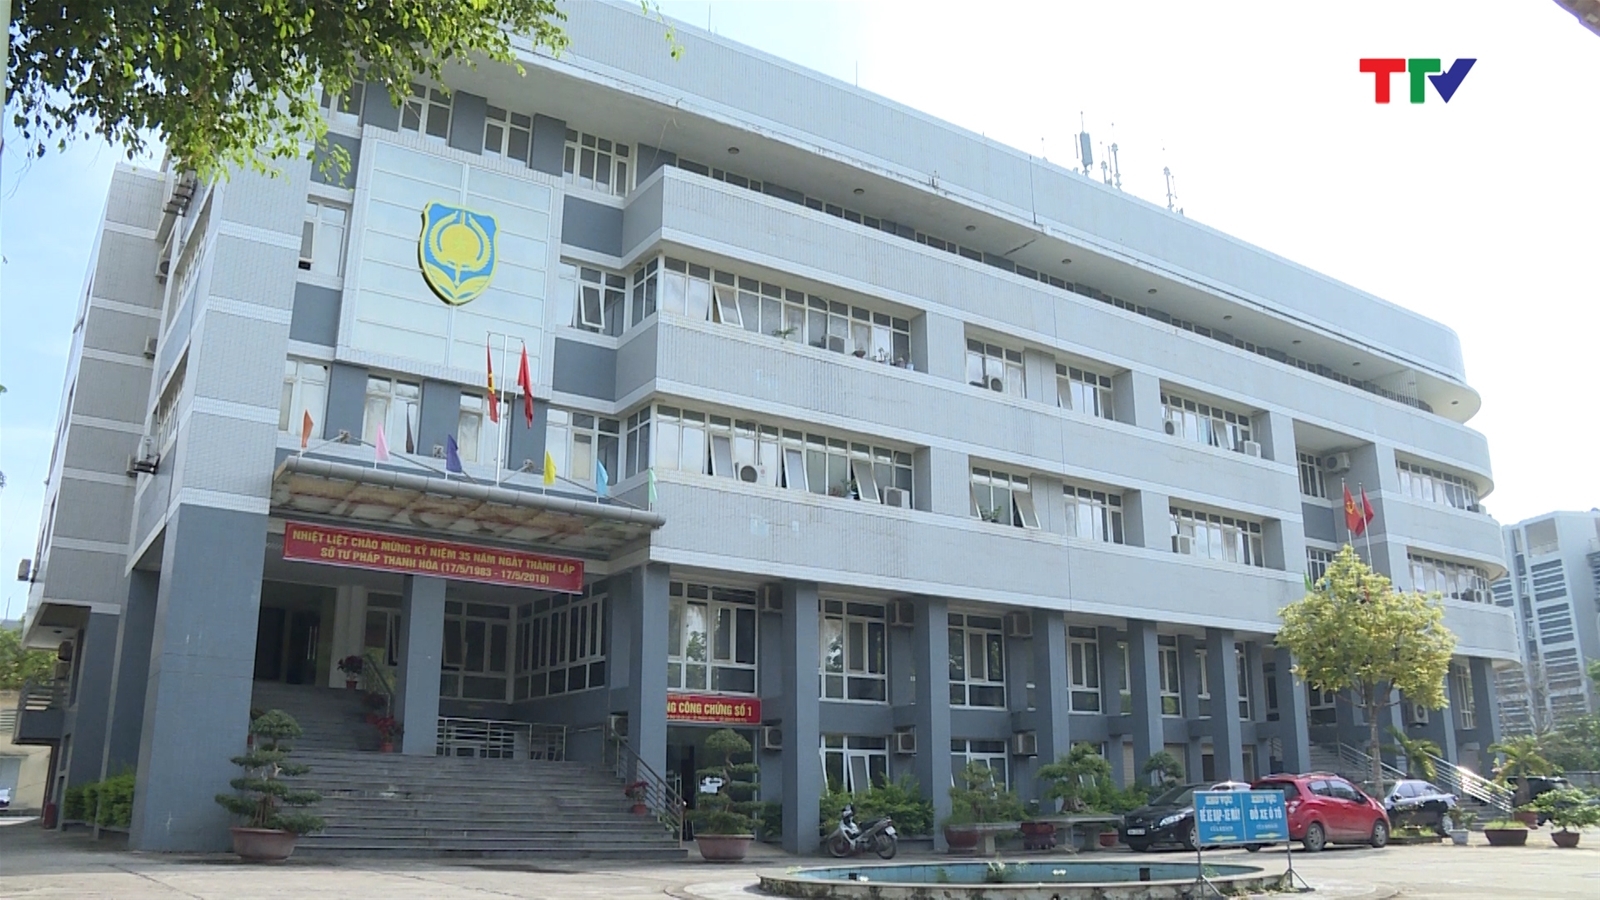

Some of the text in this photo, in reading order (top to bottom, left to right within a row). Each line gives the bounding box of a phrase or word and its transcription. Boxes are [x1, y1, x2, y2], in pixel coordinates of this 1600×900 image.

[292, 530, 324, 544] NHIỆT
[326, 534, 348, 546] LIỆT
[351, 537, 378, 550] CHÀO
[381, 540, 411, 554] MỪNG
[430, 547, 456, 560] NIỆM
[458, 551, 471, 561] 35
[473, 552, 496, 564] NĂM
[498, 555, 524, 568] NGÀY
[526, 559, 556, 571] THÀNH
[558, 563, 576, 575] LẬP
[320, 546, 336, 559] SỞ
[338, 549, 352, 560] TƯ
[353, 551, 380, 564] PHÁP
[383, 555, 416, 568] THANH
[441, 562, 492, 576] (17/5/1983
[501, 570, 549, 584] 17/5/2018)
[678, 701, 702, 714] CÔNG
[704, 702, 733, 716] CHỨNG
[734, 702, 746, 717] SỐ
[747, 705, 752, 717] 1
